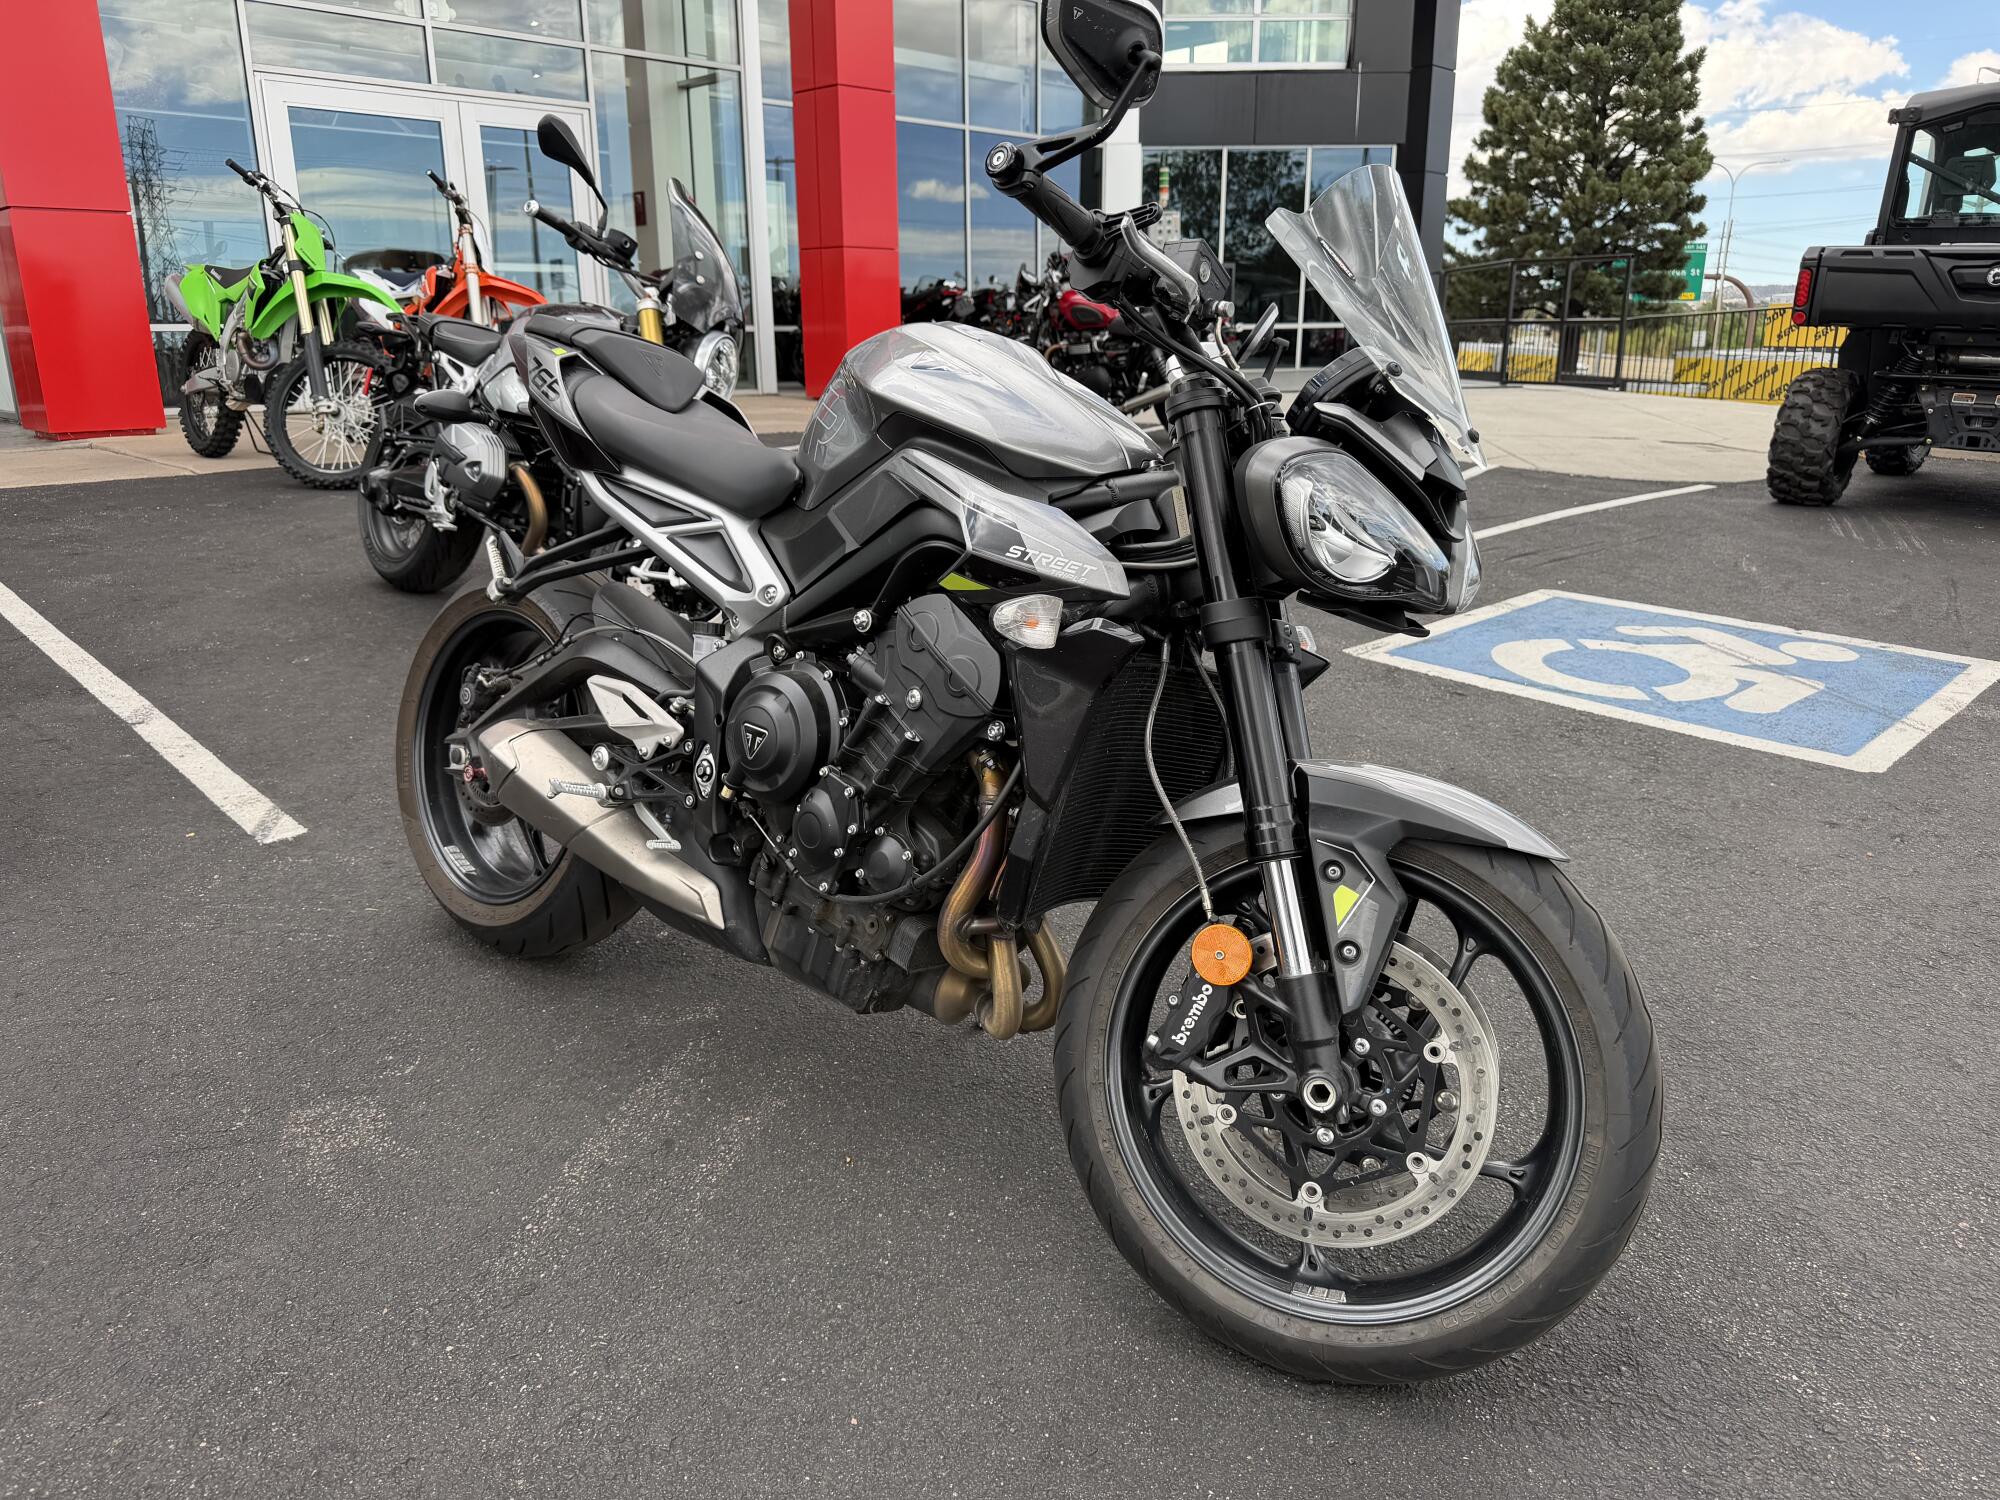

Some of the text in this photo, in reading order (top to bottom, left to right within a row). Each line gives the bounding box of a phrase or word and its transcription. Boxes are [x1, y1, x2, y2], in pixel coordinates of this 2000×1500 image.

[1690, 268, 1701, 276] St
[530, 356, 560, 401] 765
[1005, 545, 1097, 577] STREET
[1050, 570, 1088, 584] TRIPLE
[1171, 984, 1213, 1046] brembo
[1441, 1276, 1525, 1329] ROSSO
